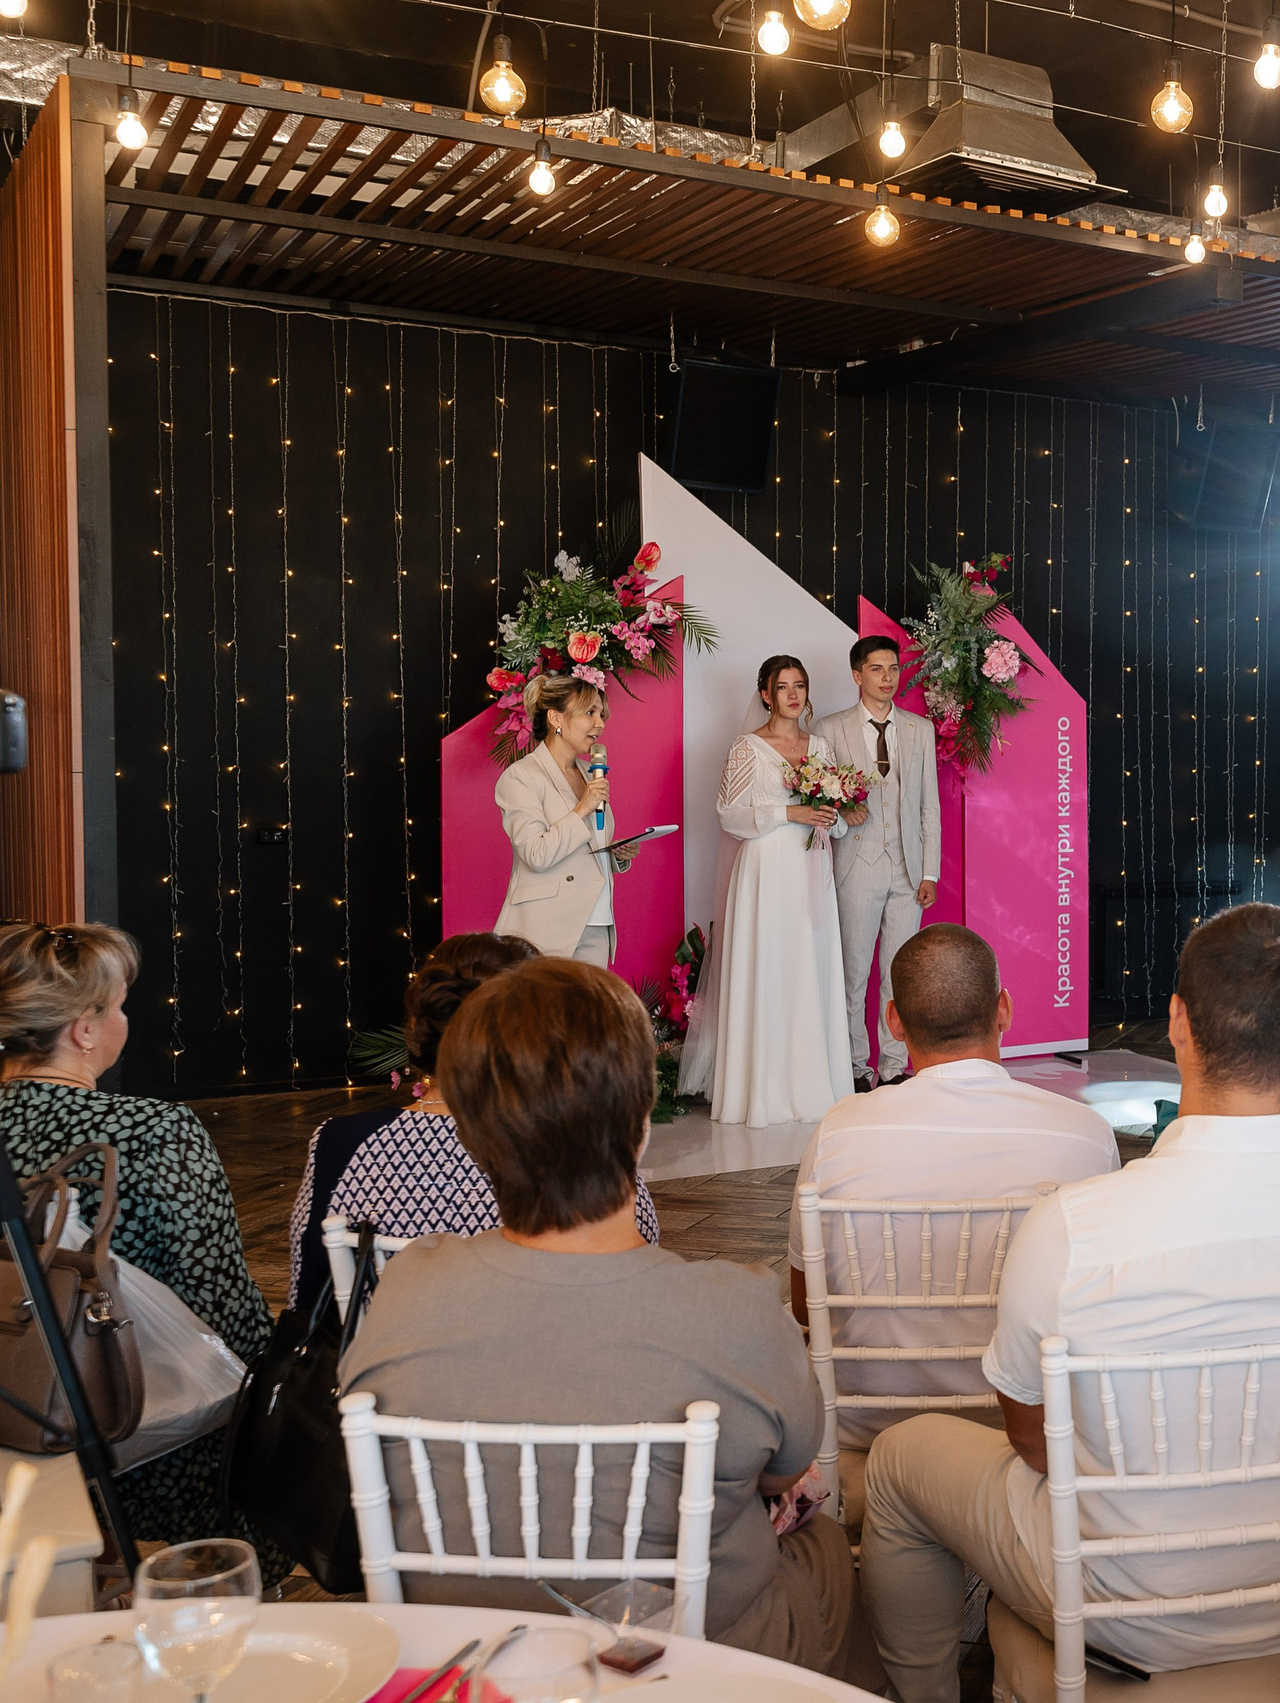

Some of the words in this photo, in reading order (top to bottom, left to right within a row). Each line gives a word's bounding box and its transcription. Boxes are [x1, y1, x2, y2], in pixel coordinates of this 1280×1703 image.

[1057, 716, 1073, 817] каждого
[1057, 824, 1075, 906] внутри
[1053, 913, 1074, 1008] Красота
